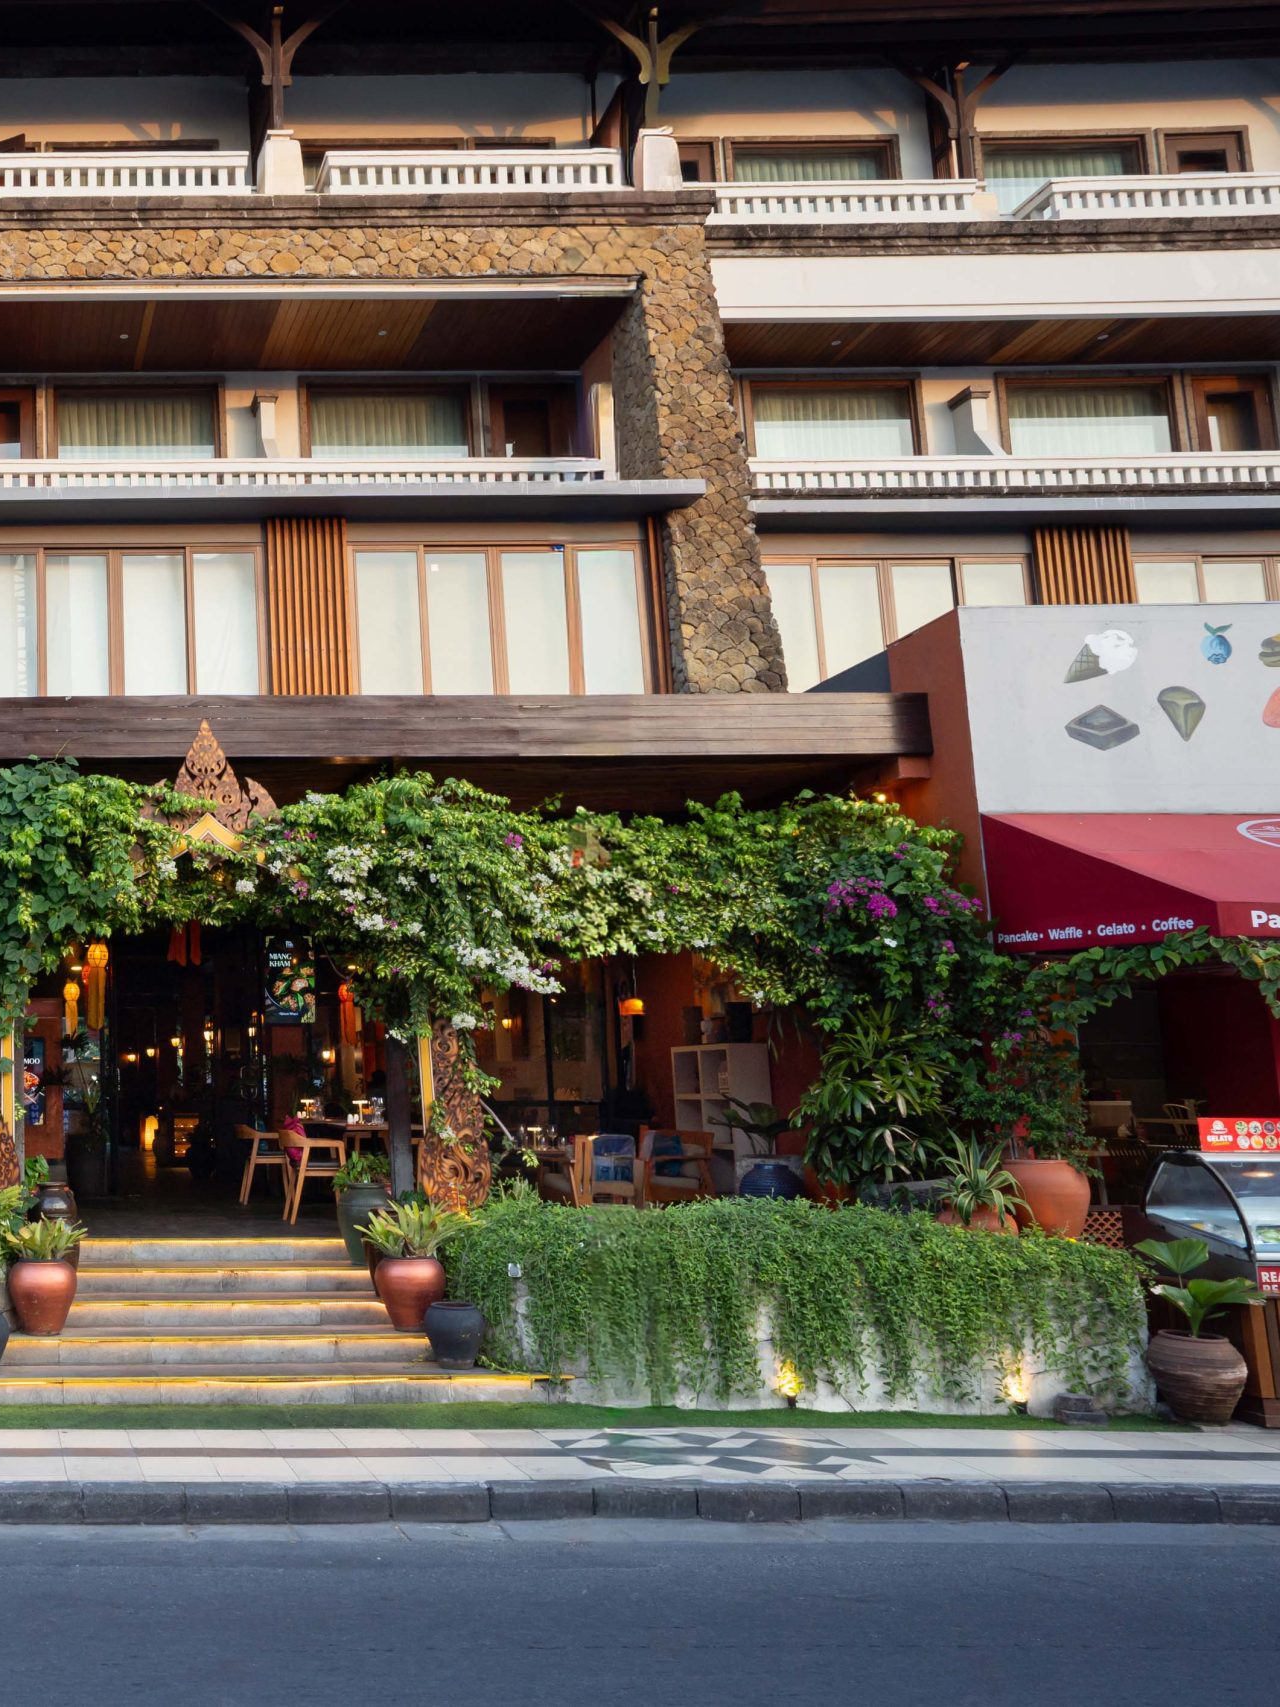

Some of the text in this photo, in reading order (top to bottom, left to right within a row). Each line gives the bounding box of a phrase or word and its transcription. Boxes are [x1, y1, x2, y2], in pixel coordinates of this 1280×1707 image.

[997, 917, 1195, 944] Pancake Waffle Gelato Coffee
[269, 960, 291, 968] KHAM
[1261, 1271, 1280, 1283] RE
